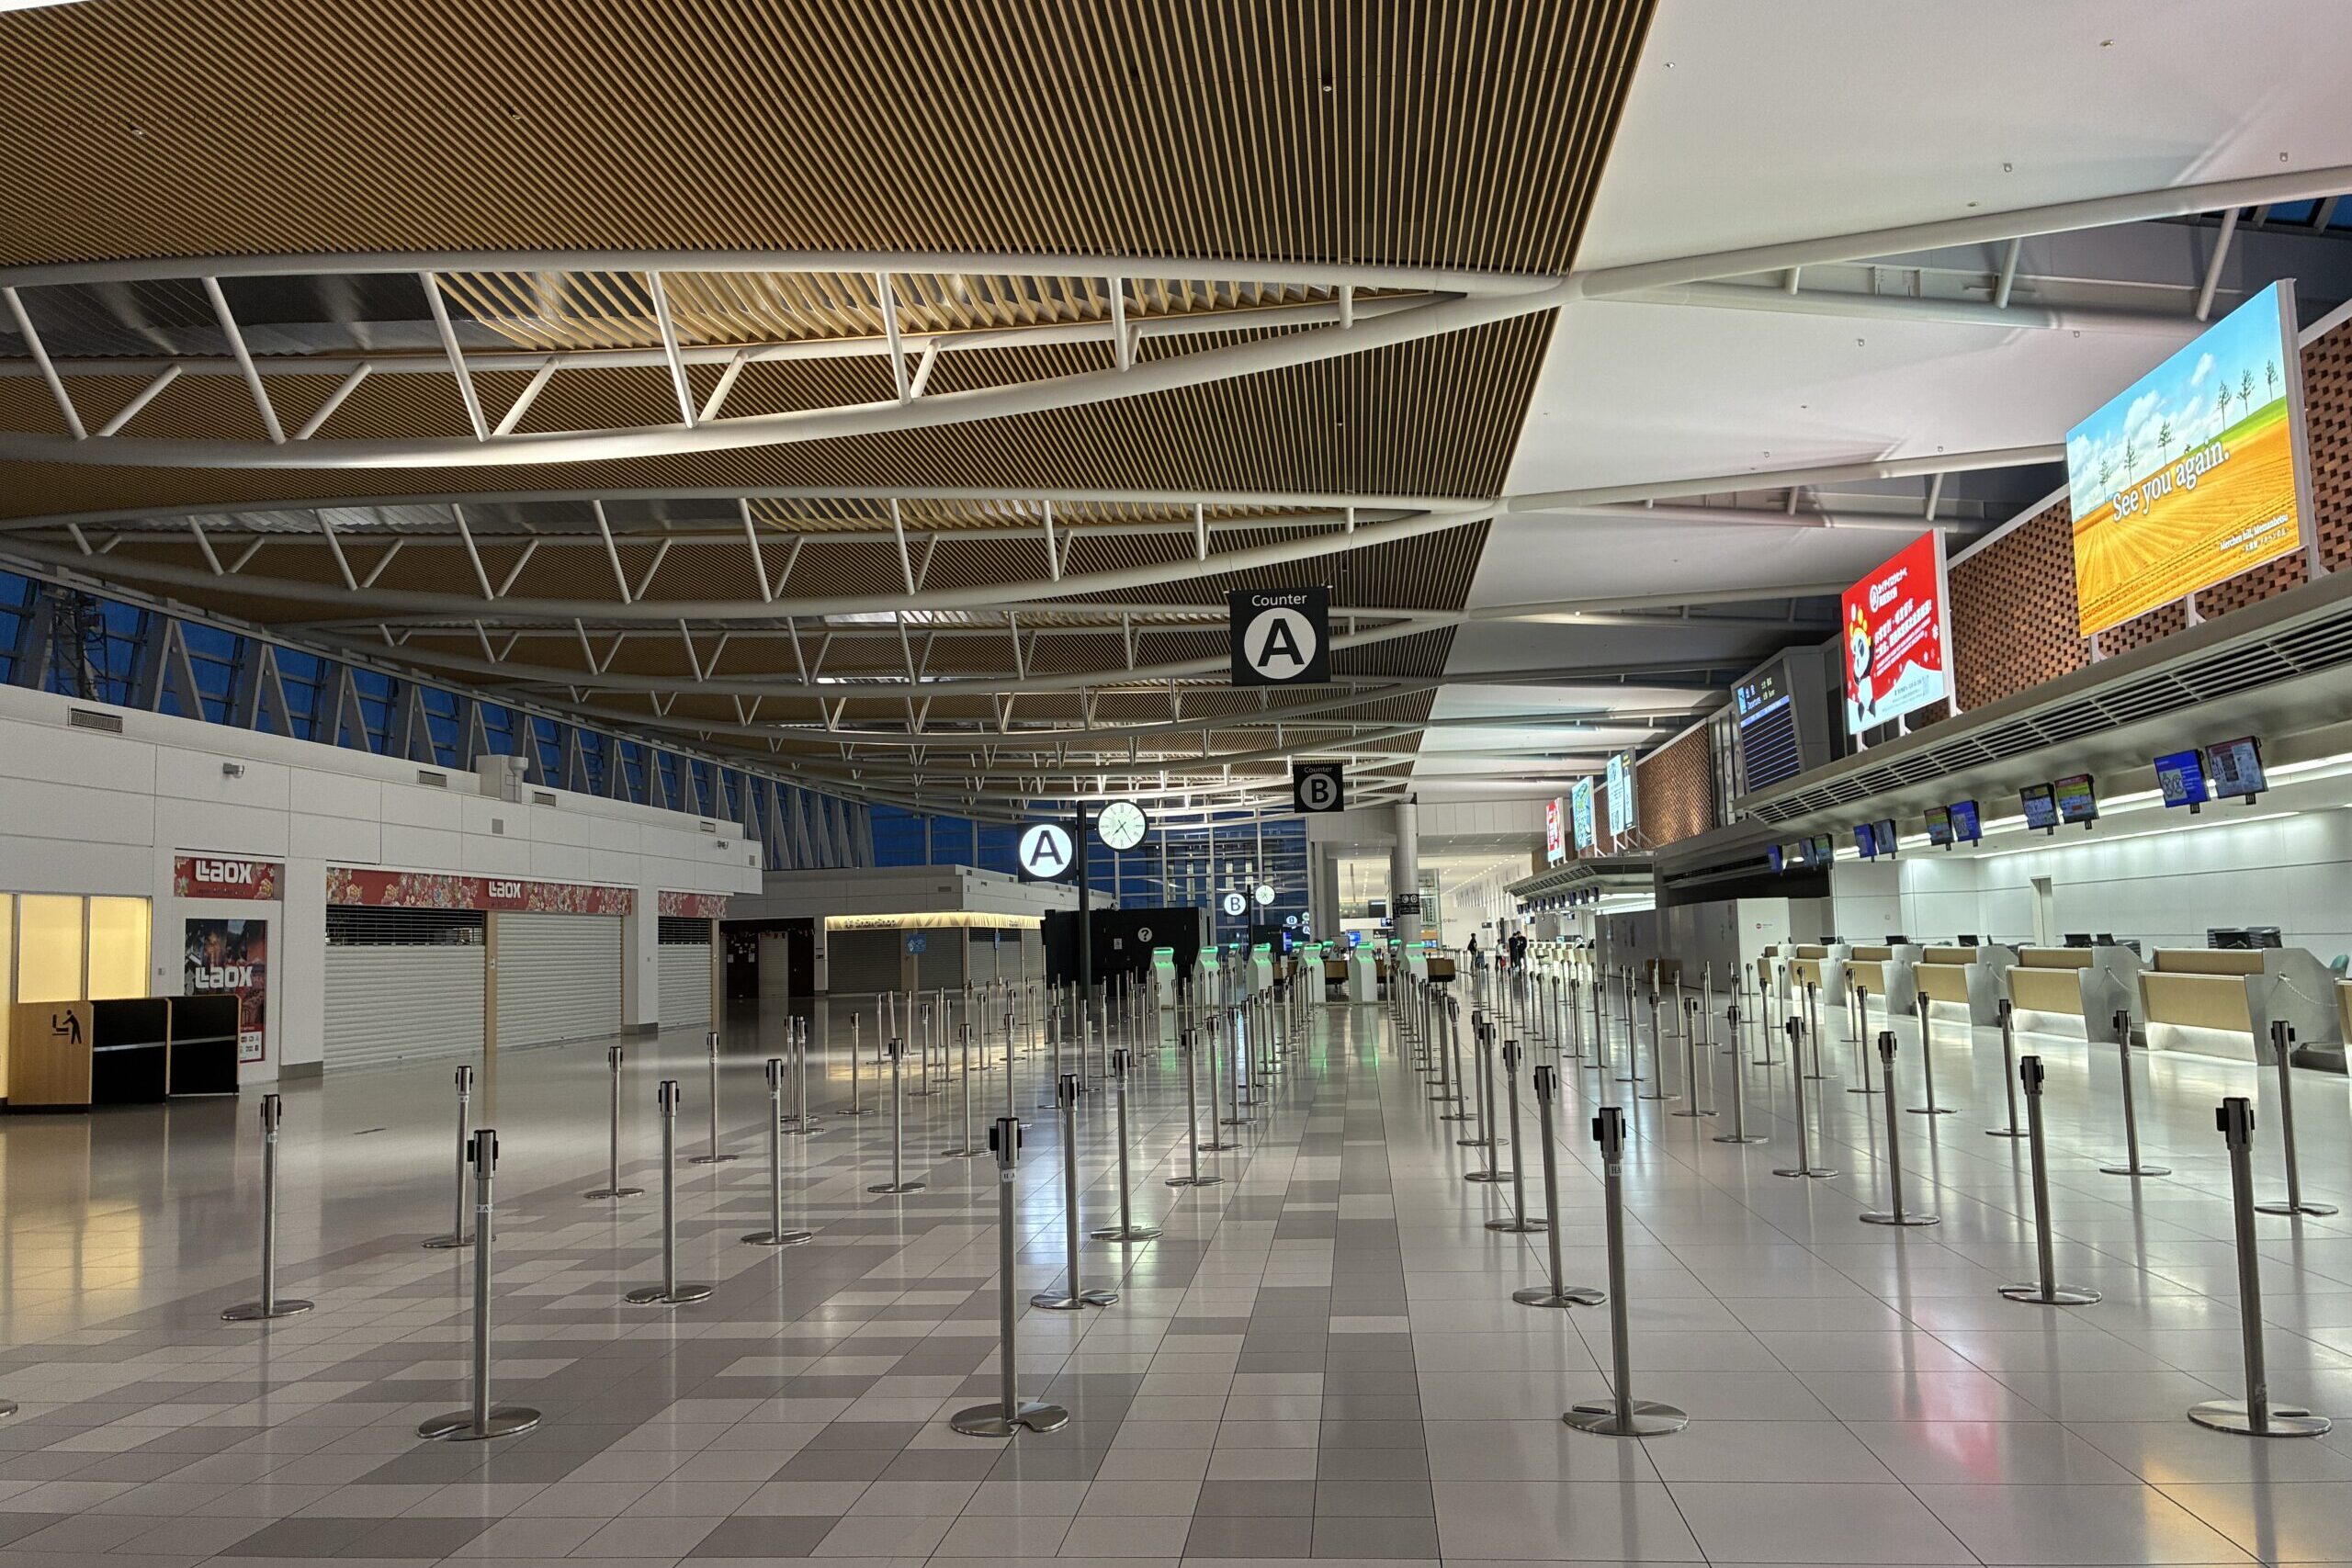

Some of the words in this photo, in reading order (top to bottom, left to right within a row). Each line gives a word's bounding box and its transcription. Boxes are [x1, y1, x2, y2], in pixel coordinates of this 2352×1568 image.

[2112, 491, 2139, 522] See
[2142, 468, 2172, 514] you
[2176, 437, 2230, 490] again.
[1251, 594, 1307, 606] Counter
[1257, 618, 1305, 667] A
[1311, 779, 1329, 803] B
[1029, 829, 1064, 866] A
[1230, 897, 1241, 911] B
